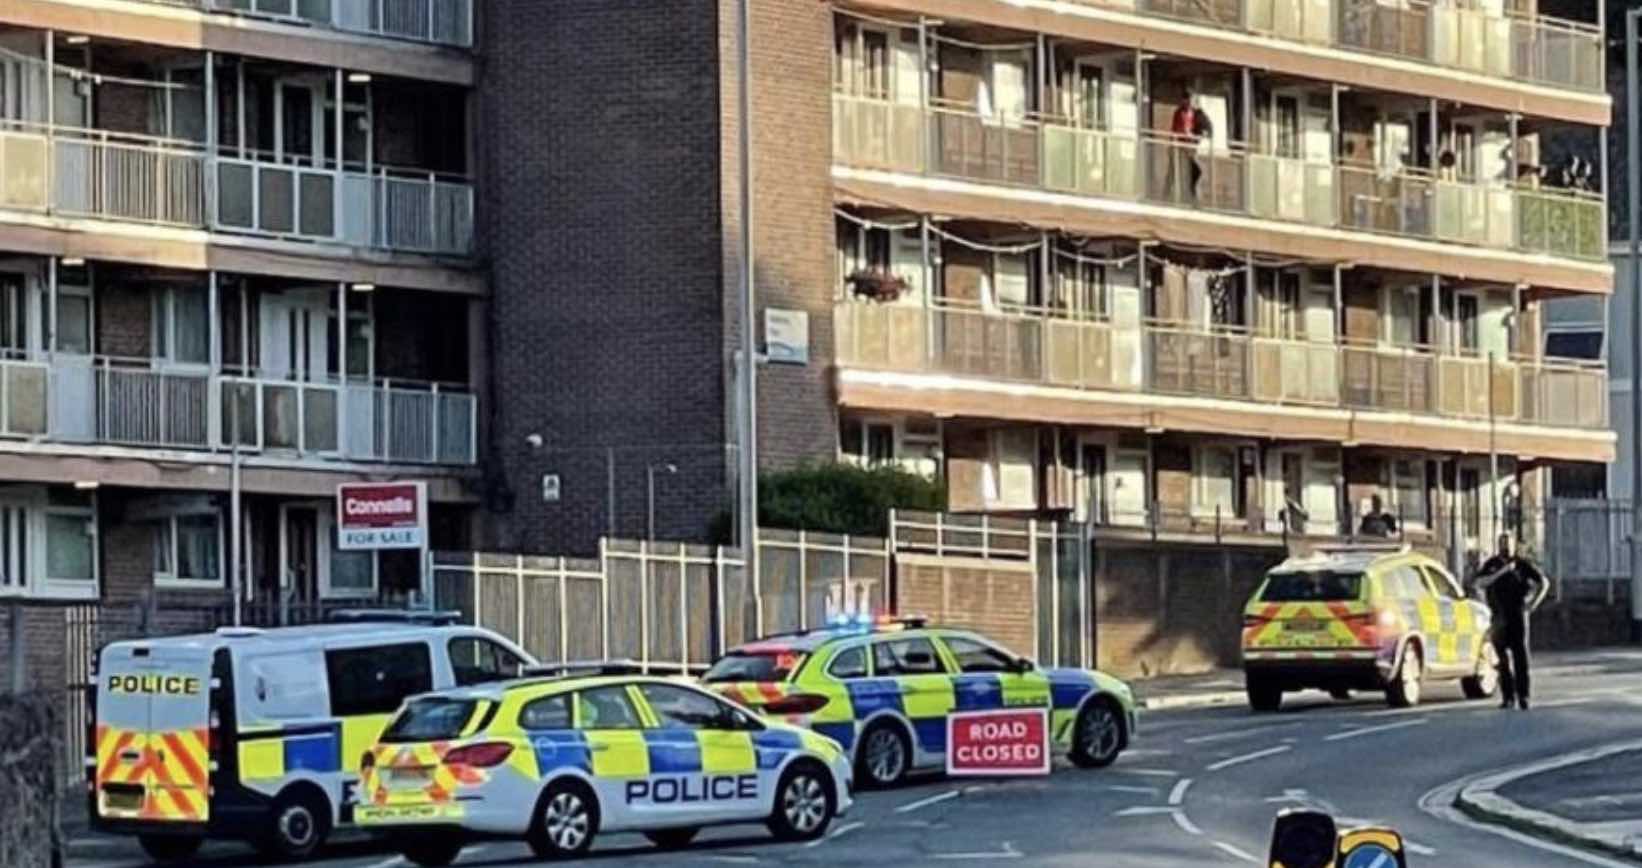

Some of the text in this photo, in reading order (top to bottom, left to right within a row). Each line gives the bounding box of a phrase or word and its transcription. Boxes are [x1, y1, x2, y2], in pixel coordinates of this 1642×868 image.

[347, 531, 413, 544] FOR SALE
[108, 675, 200, 694] POLICE
[970, 722, 1027, 740] ROAD
[957, 744, 1040, 761] CLOSED
[626, 774, 758, 804] POLICE
